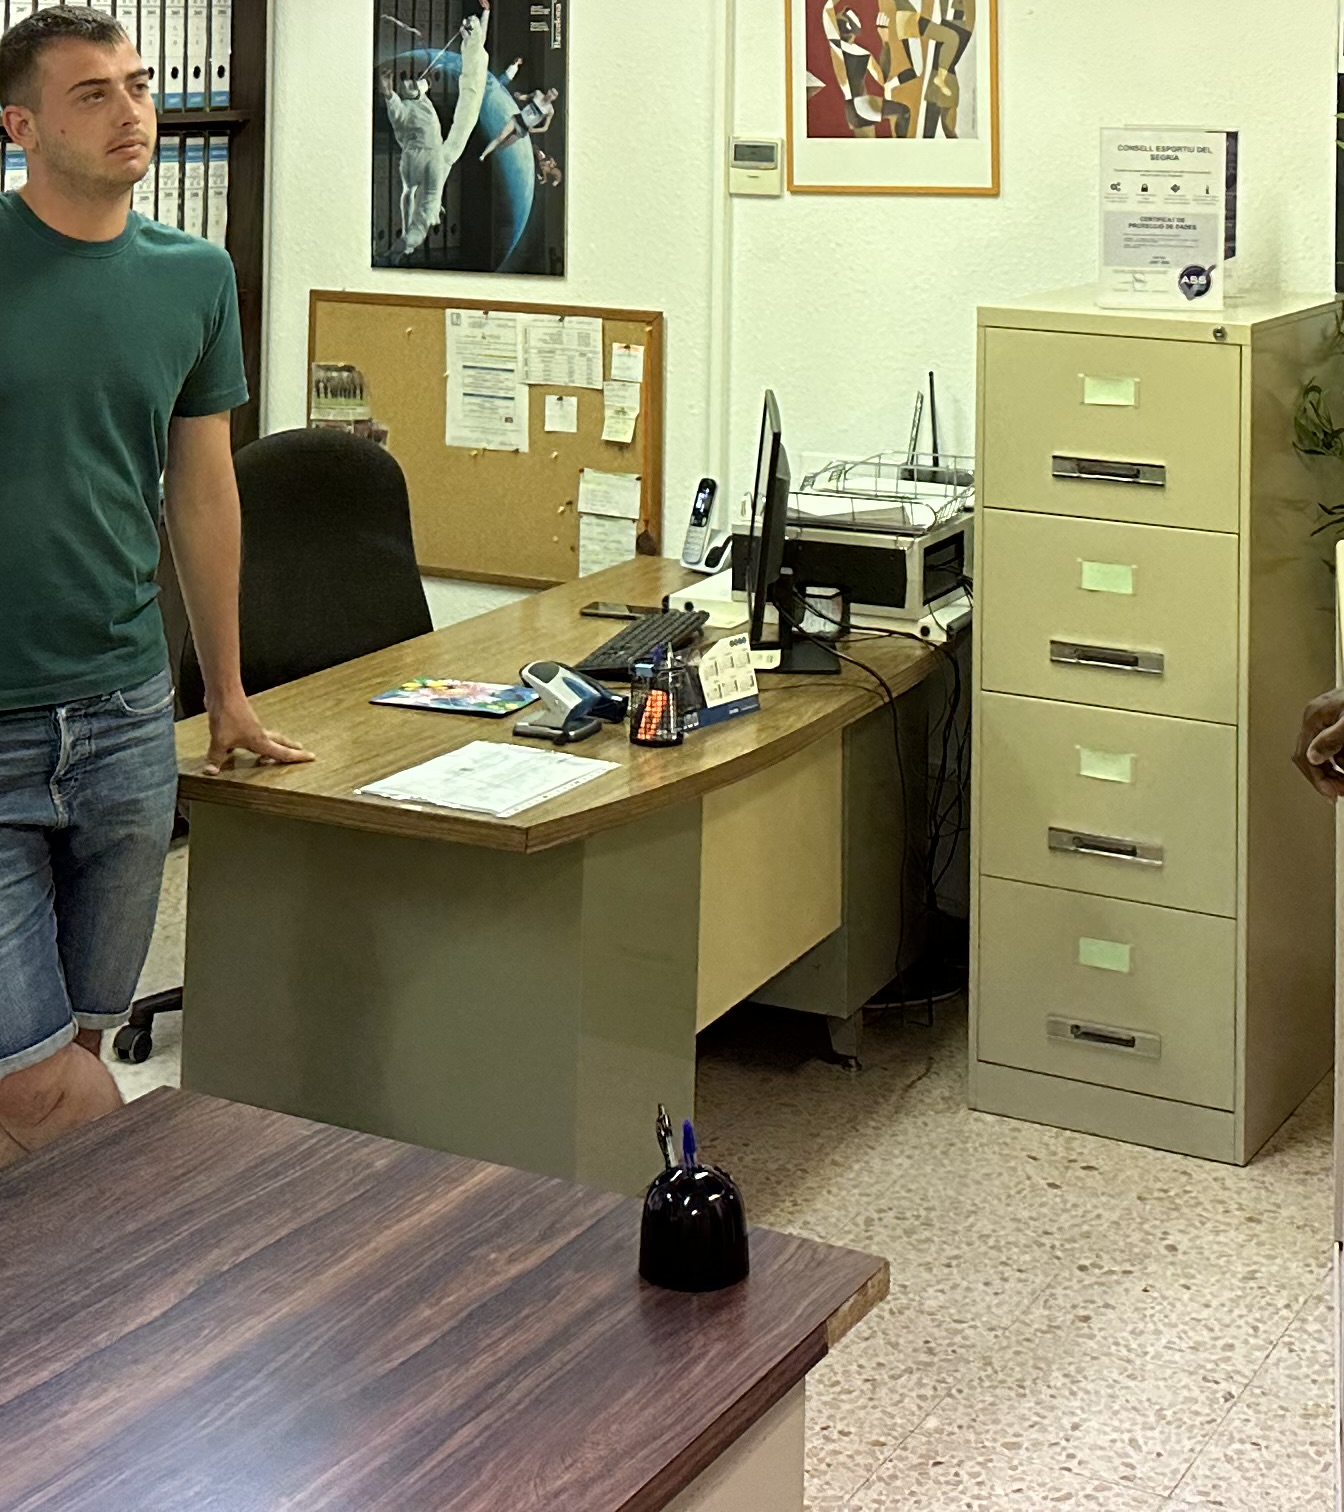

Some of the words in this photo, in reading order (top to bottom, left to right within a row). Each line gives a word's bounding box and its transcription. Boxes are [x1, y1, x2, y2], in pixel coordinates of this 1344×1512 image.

[1117, 144, 1154, 152] CONSELL
[1155, 145, 1195, 153] ESPORTIU
[1196, 146, 1213, 154] DEL
